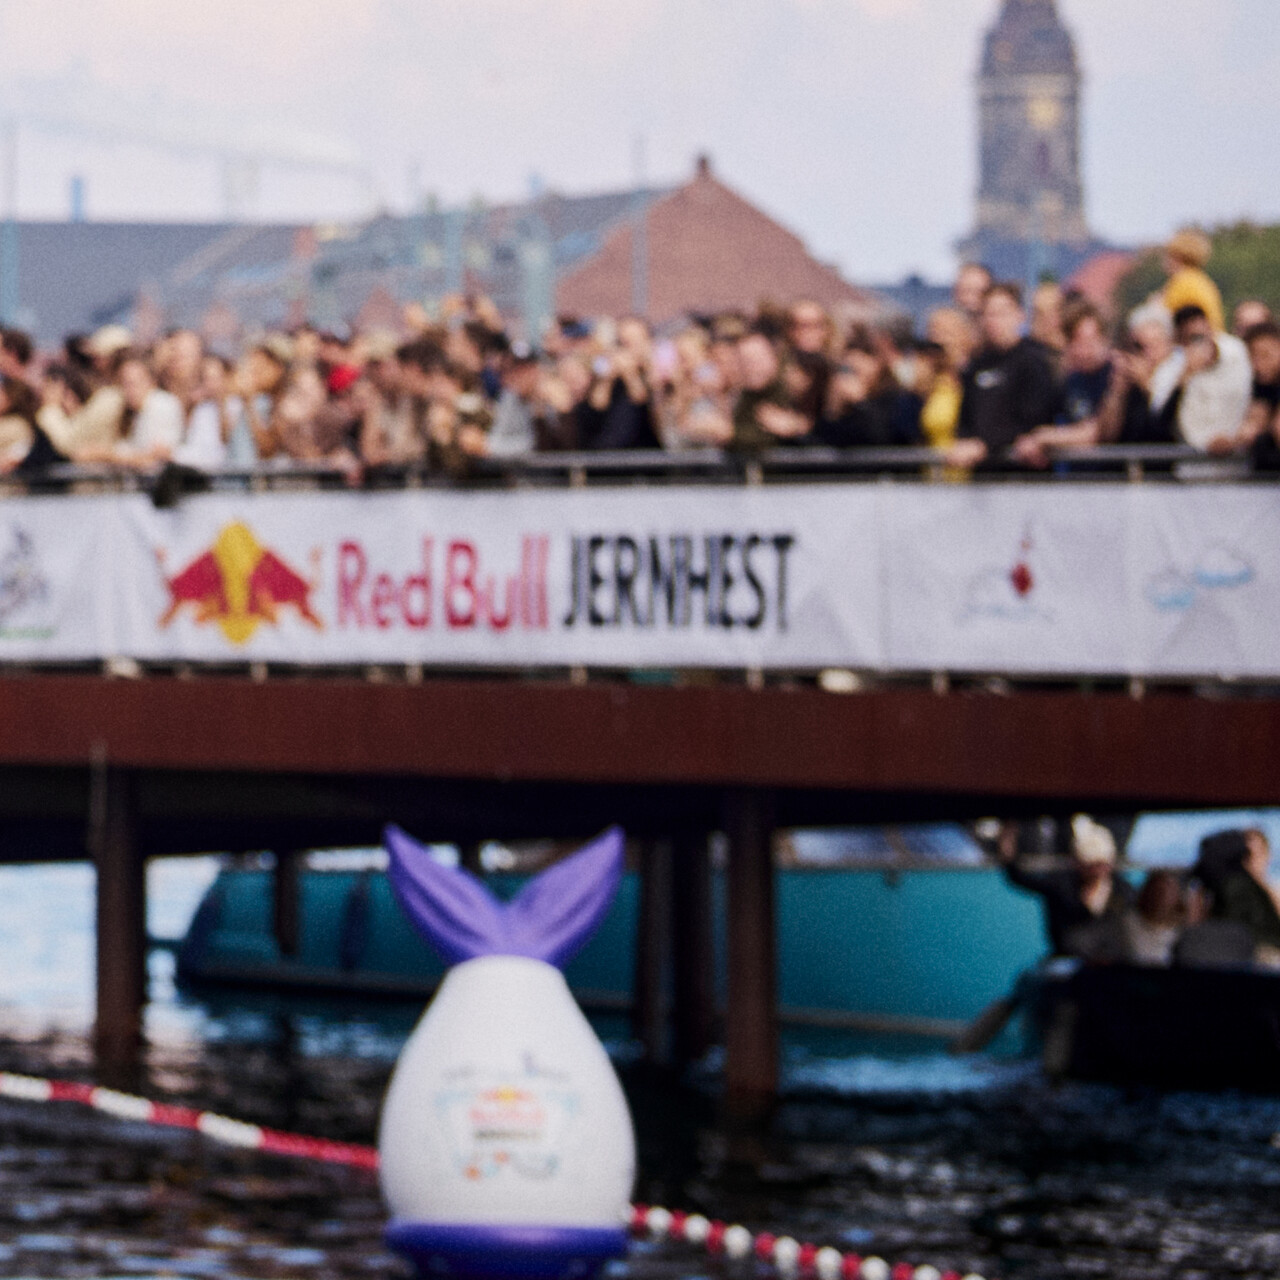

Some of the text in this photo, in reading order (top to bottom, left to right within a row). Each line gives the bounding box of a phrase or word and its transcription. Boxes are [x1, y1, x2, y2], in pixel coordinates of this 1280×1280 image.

[337, 532, 796, 632] Red Bull JERNHEST
